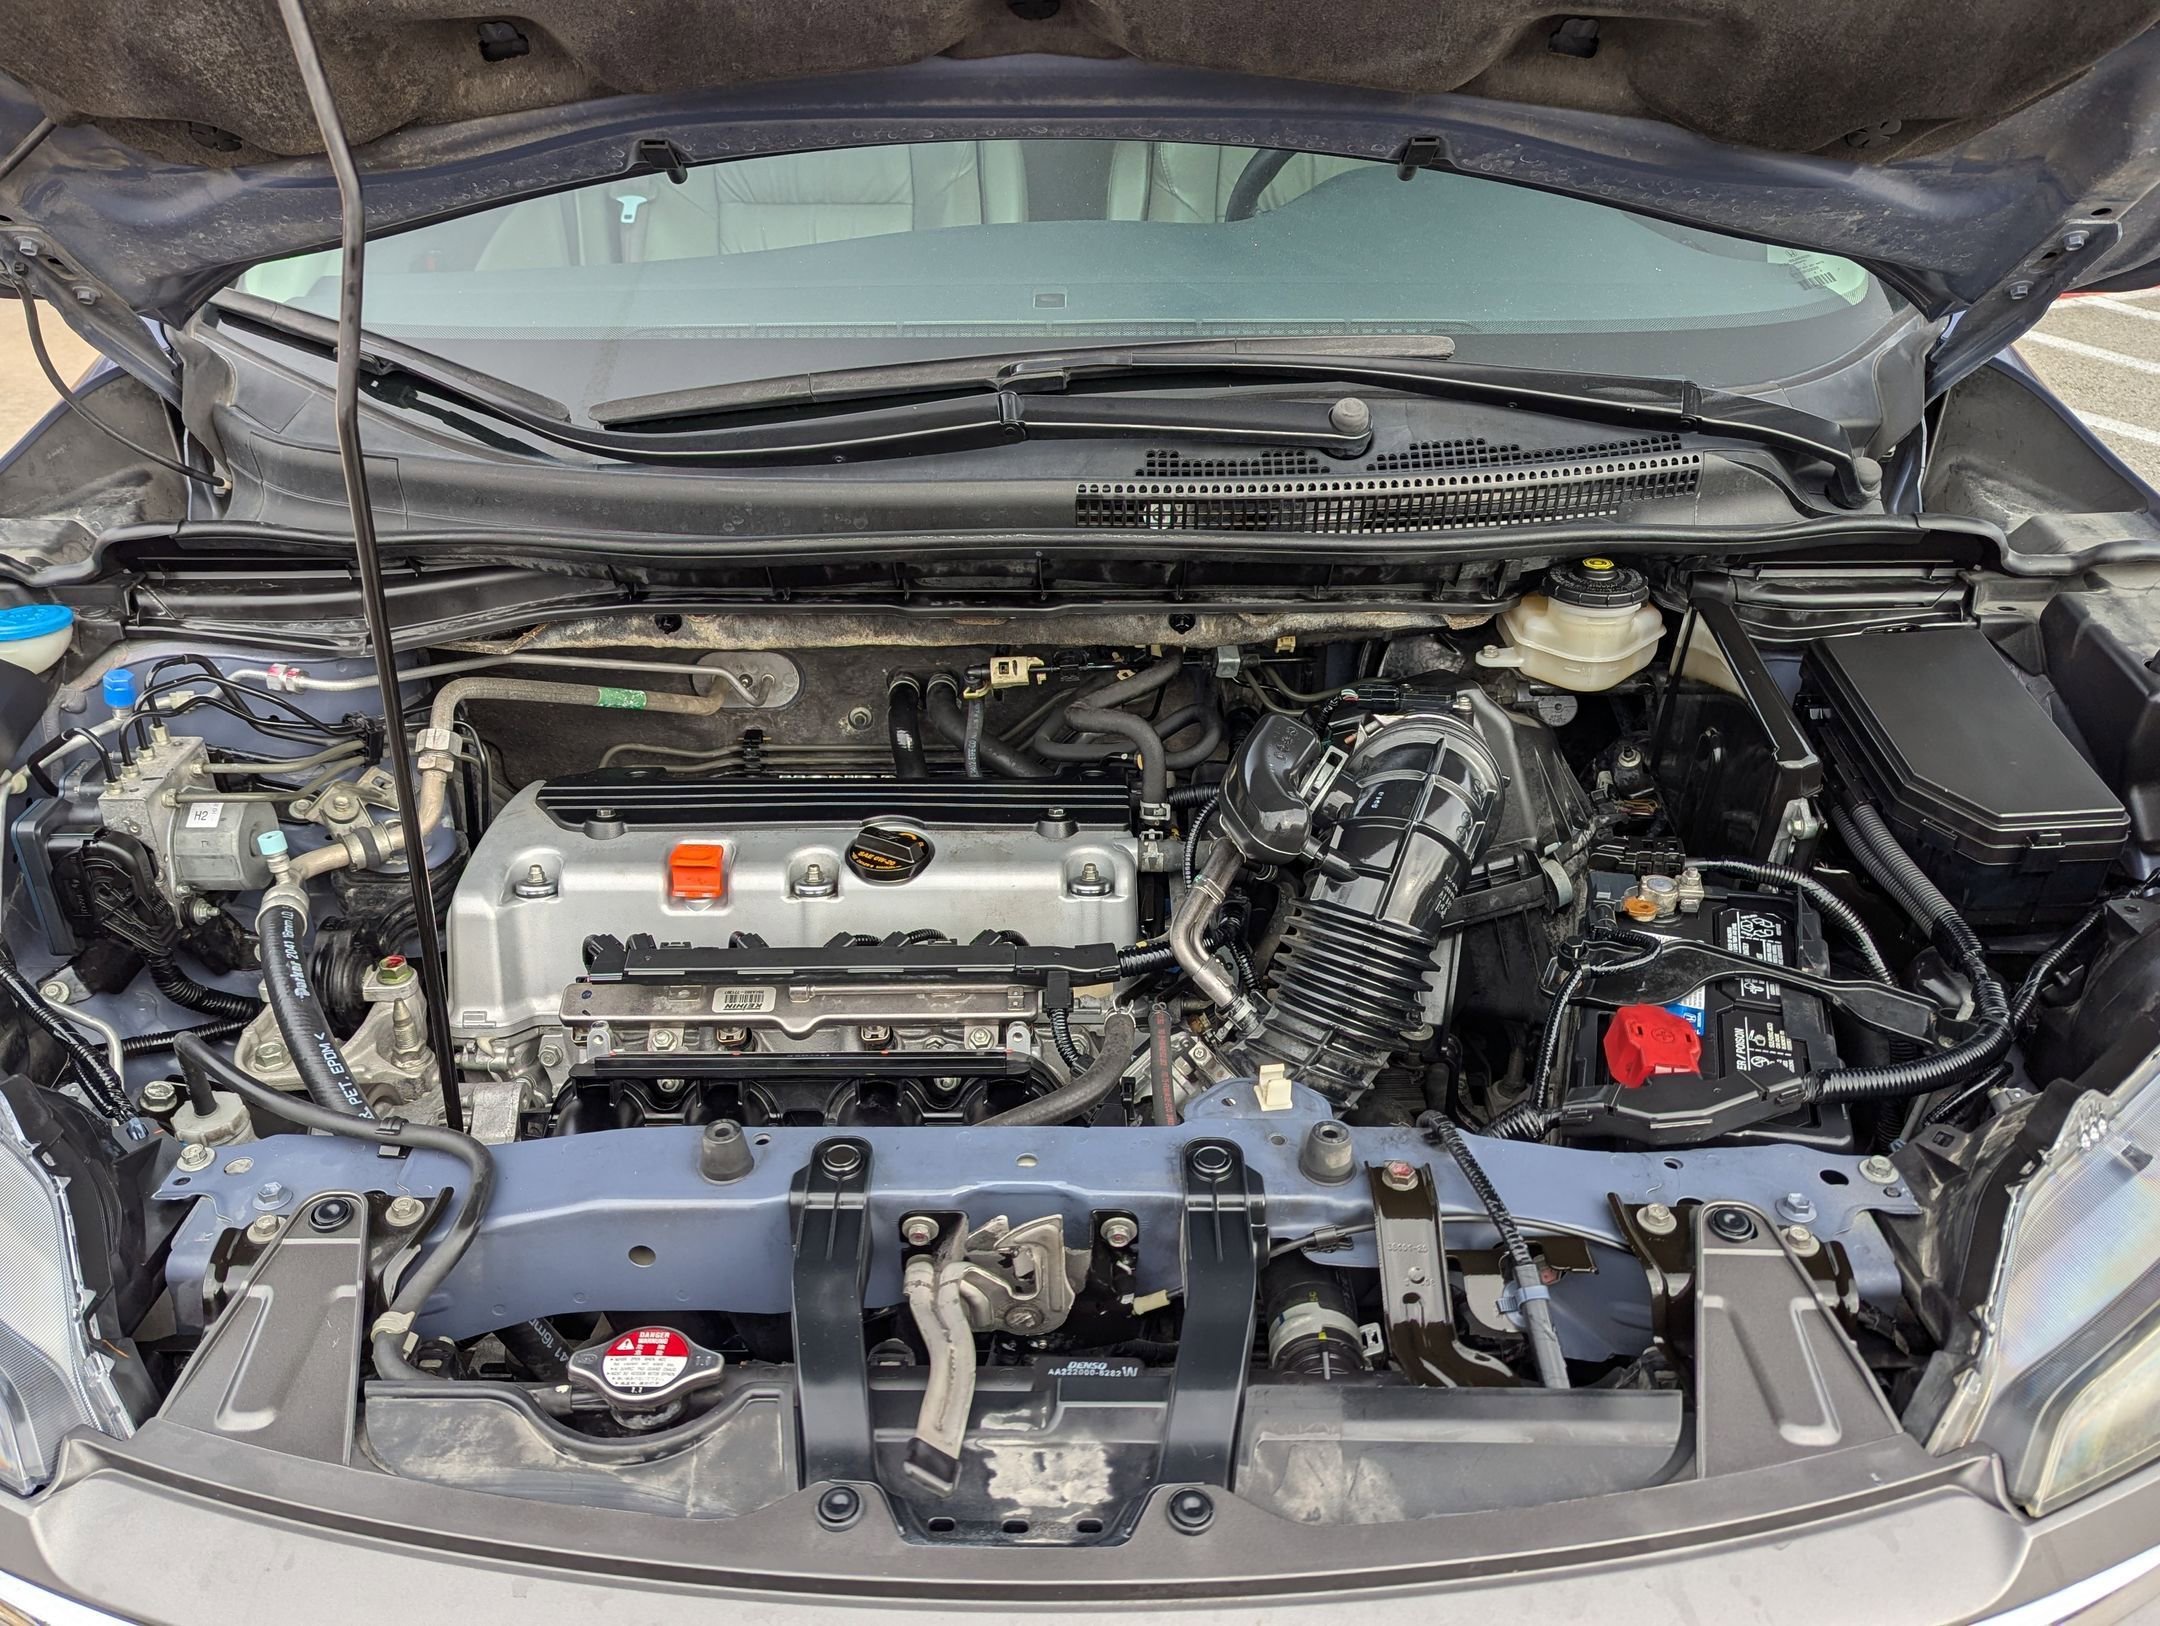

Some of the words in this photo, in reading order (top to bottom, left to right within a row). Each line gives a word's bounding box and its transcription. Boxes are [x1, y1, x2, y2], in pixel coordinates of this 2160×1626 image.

[194, 810, 209, 821] H2
[286, 940, 299, 960] 2041
[290, 960, 311, 999] Parker
[319, 1042, 344, 1075] EPDM
[1067, 1361, 1108, 1369] DENSO
